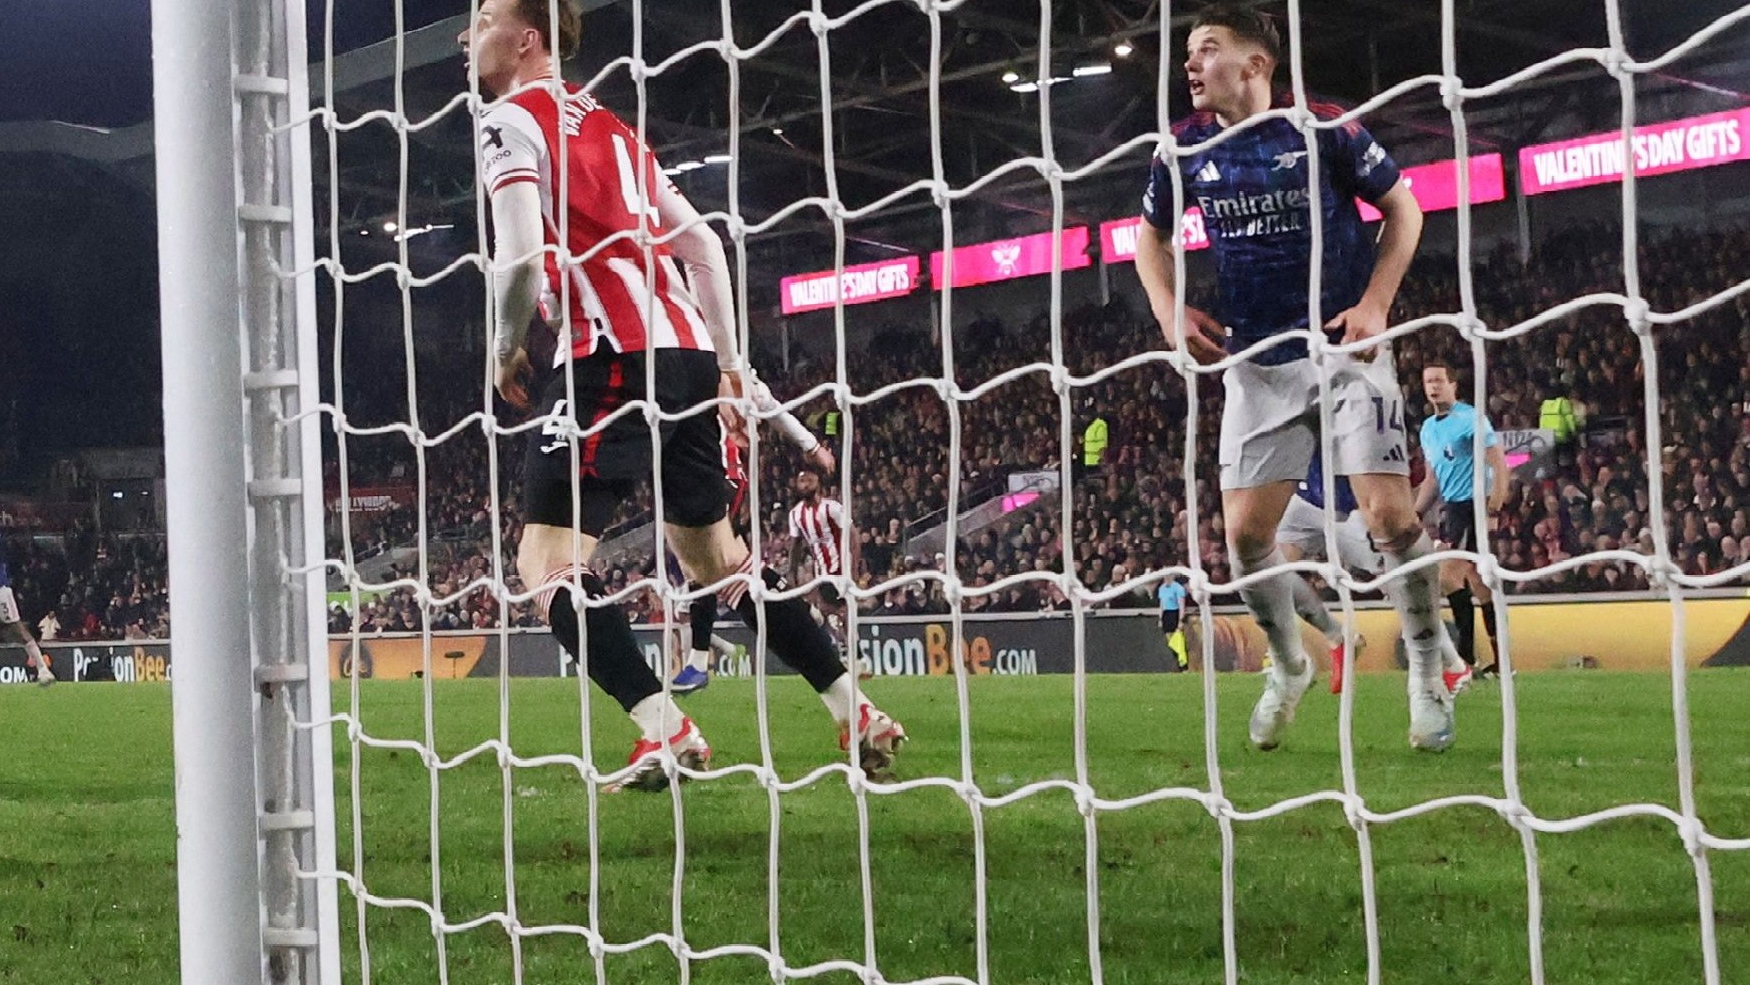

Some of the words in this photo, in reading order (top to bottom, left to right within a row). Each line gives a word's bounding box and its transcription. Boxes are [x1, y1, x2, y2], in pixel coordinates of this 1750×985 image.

[1533, 137, 1648, 186] VALENTIN'S
[1648, 128, 1685, 169] DAY
[1686, 119, 1741, 160] GIFTS
[789, 271, 858, 307] VALENTIE'S
[877, 263, 910, 293] GIFTS
